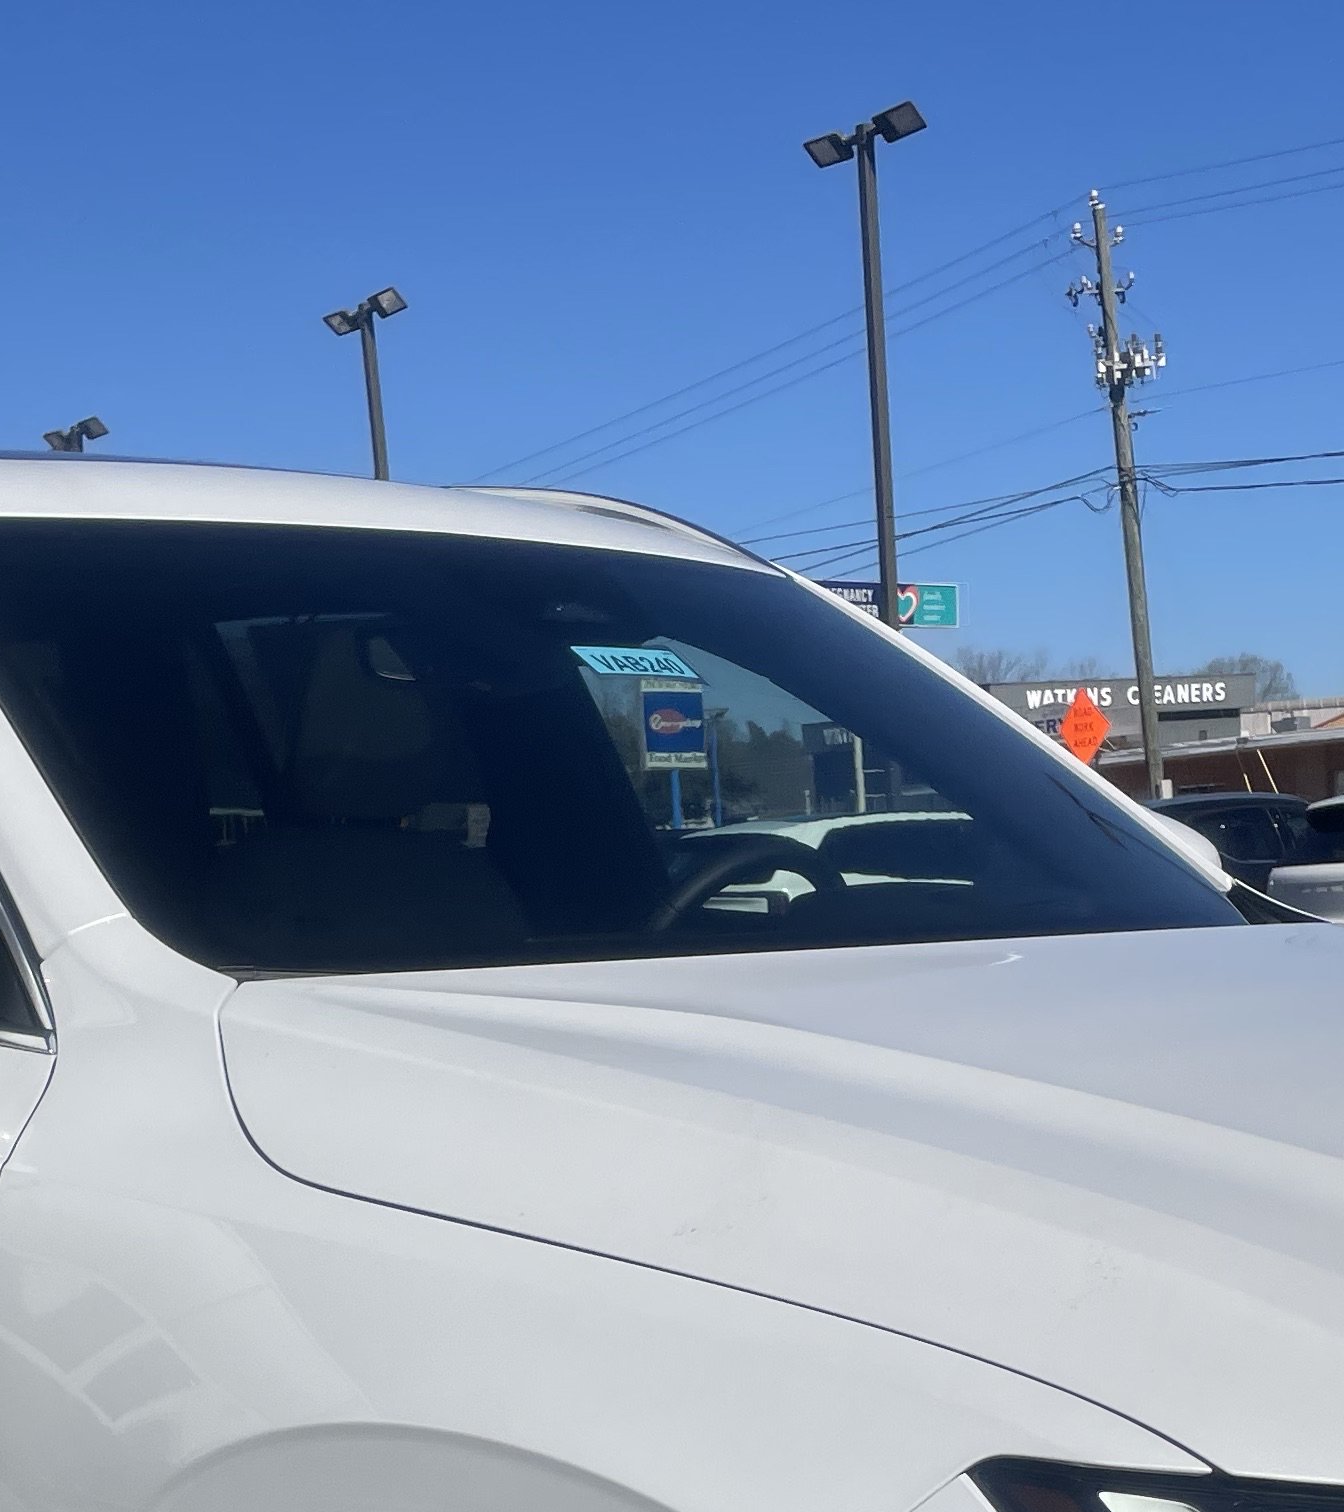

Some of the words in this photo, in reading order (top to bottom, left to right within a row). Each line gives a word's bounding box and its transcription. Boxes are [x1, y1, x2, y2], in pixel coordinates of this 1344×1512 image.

[590, 654, 685, 675] VAB240
[1026, 687, 1112, 710] WATKNS
[1127, 682, 1226, 705] CEANERS
[1073, 707, 1094, 717] ROAD
[1074, 722, 1094, 732] WORK
[1074, 736, 1097, 748] AHEAD
